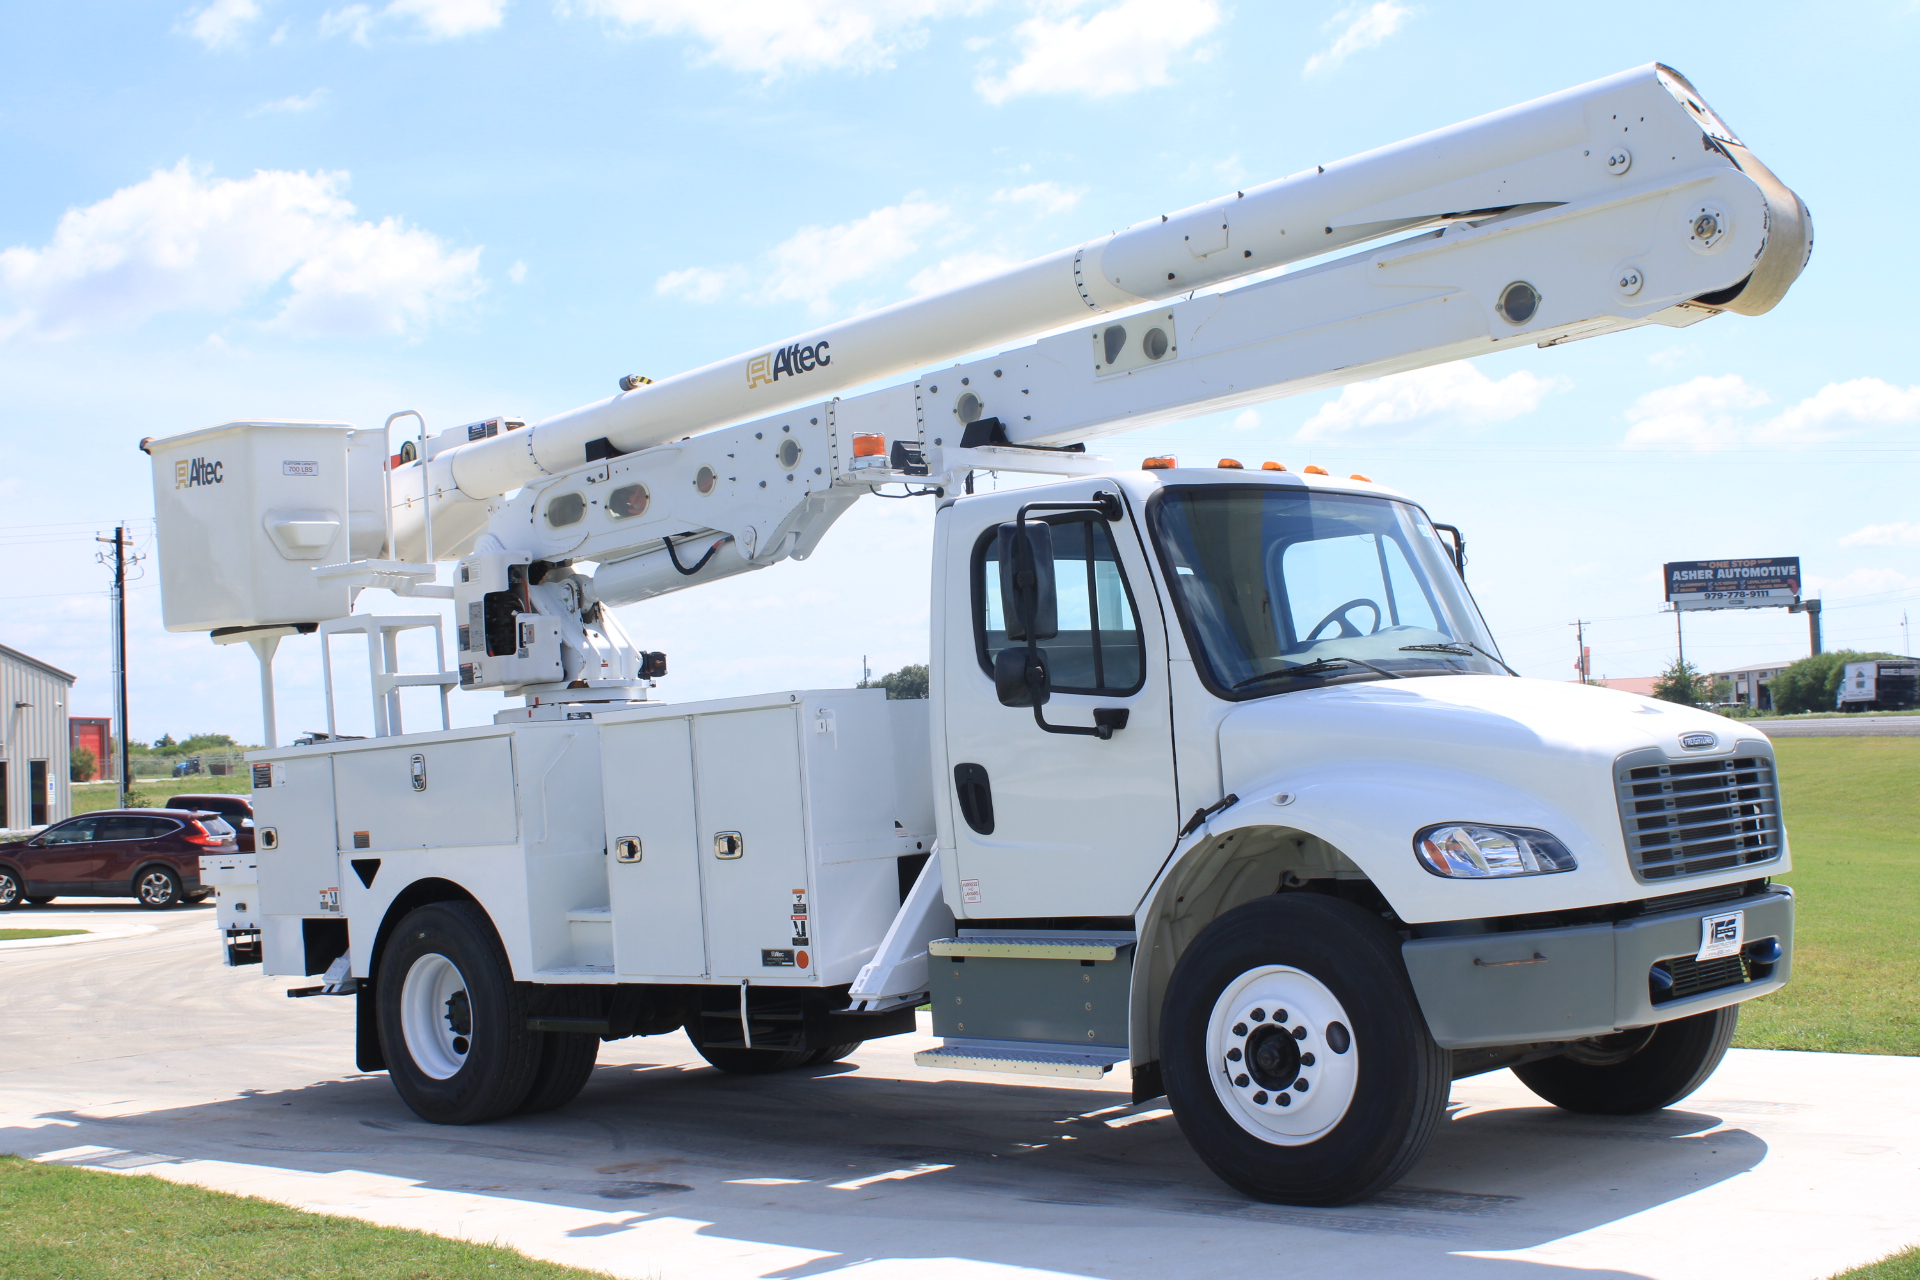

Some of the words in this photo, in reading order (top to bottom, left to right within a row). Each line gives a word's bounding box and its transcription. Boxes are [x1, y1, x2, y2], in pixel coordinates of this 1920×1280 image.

[773, 340, 831, 382] Altec
[189, 456, 224, 488] Altec
[1708, 560, 1730, 569] ONE
[1731, 559, 1757, 568] STOP
[1672, 570, 1713, 580] ASHER
[1717, 566, 1797, 578] AUTOMOTIVE
[1704, 590, 1769, 600] 979-778-9111
